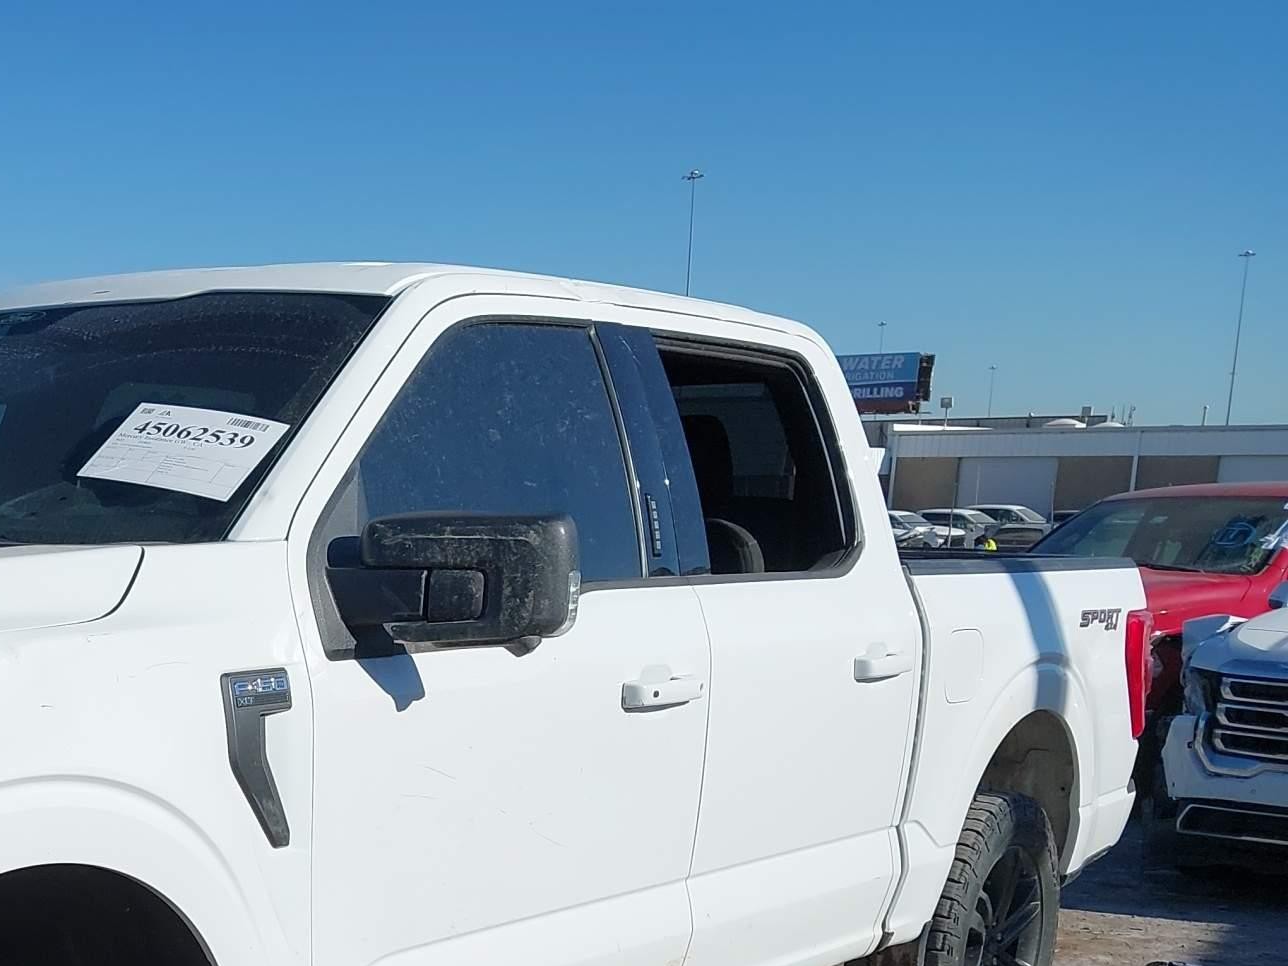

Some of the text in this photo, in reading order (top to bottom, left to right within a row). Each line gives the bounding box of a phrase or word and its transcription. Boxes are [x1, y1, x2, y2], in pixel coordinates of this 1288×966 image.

[841, 355, 905, 370] WATER
[134, 420, 256, 449] 45062539
[1080, 608, 1122, 628] SPORT
[234, 676, 289, 696] F-150
